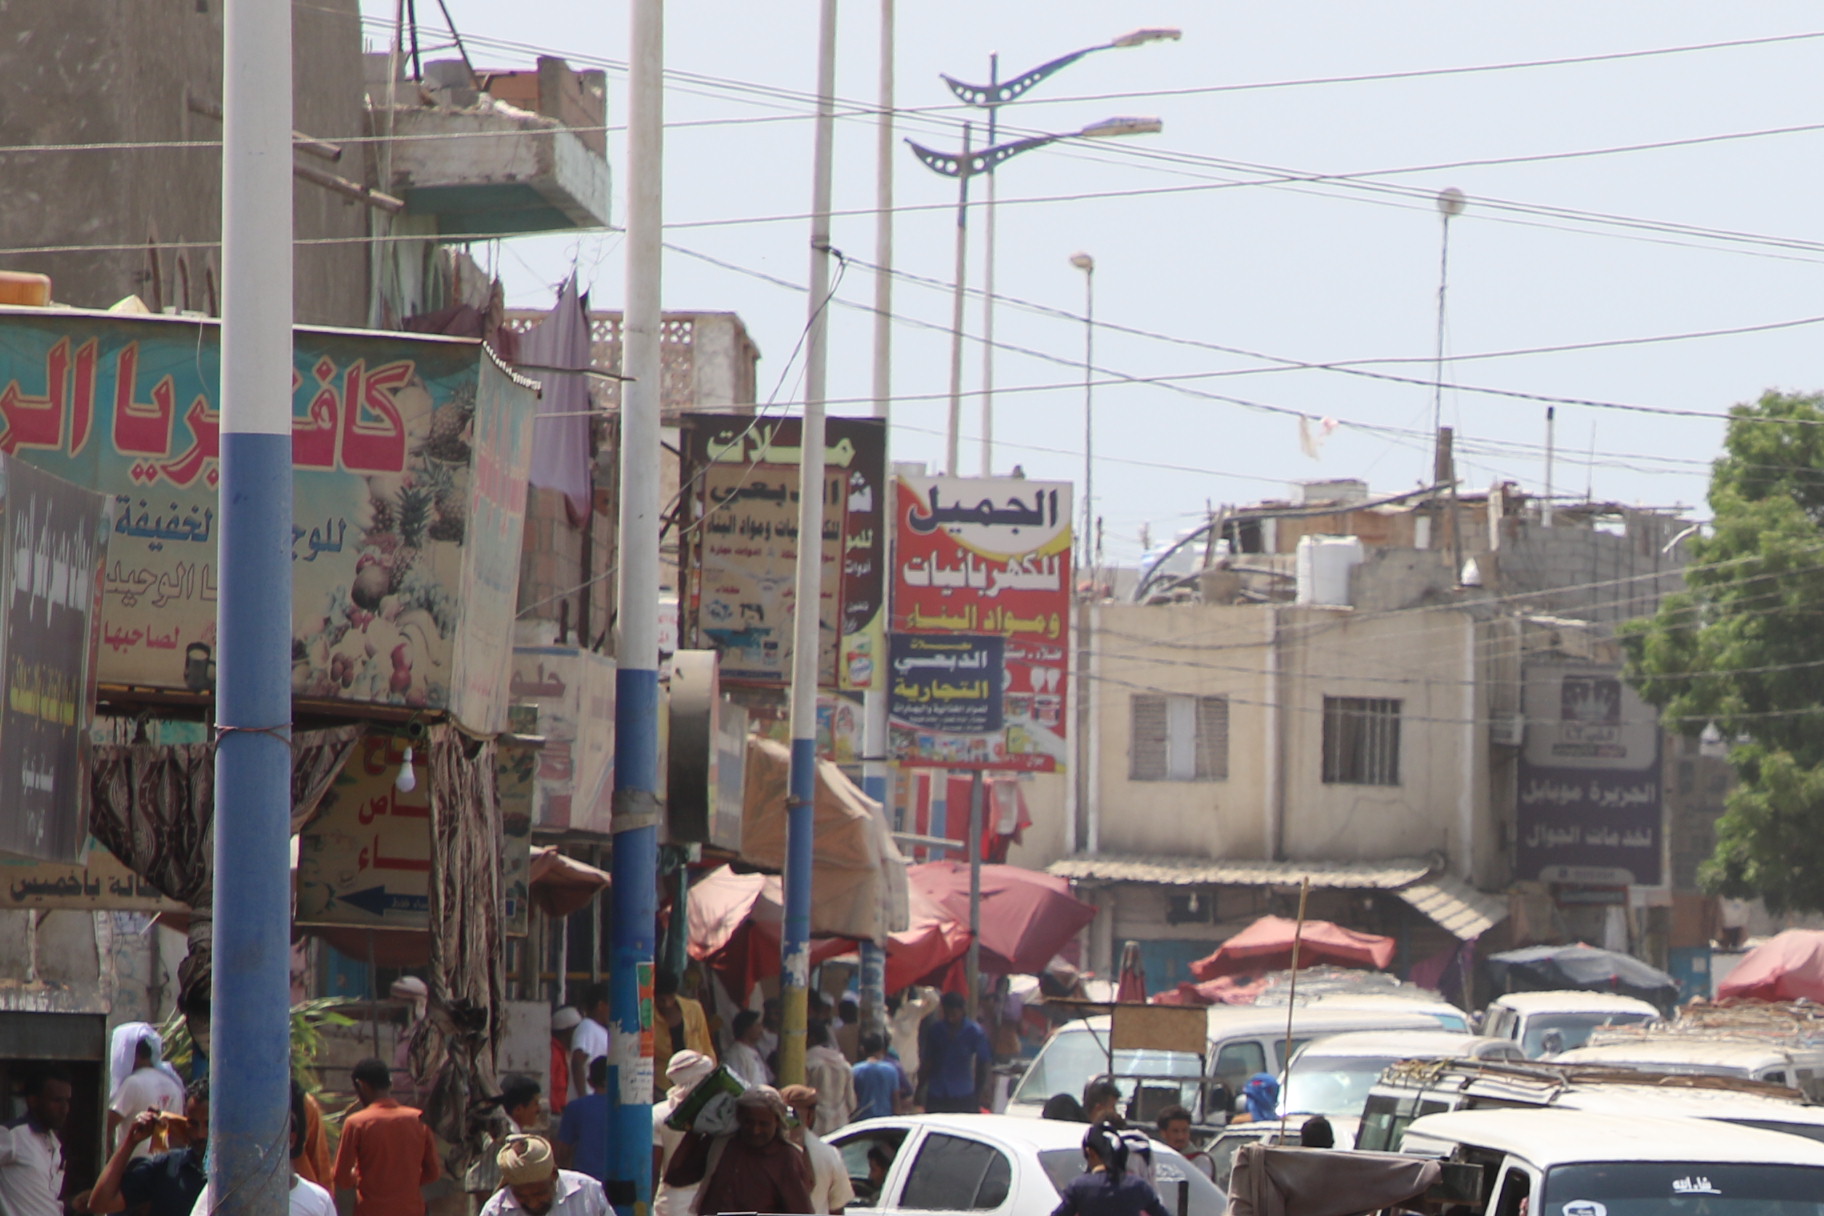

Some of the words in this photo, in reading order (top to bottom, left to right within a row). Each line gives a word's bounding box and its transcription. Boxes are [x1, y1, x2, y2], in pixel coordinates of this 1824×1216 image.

[707, 424, 856, 468] ملات
[114, 495, 213, 552] لخفيفة
[909, 485, 1057, 534] الجميل
[105, 561, 195, 608] الوحيد
[903, 548, 1060, 597] للكهربائيات
[905, 603, 976, 635] البناء
[983, 604, 1060, 639] ومواد
[104, 621, 180, 654] لصاحبها
[894, 679, 989, 702] التجارية
[1520, 779, 1583, 806] موبايل
[1524, 824, 1581, 848] الجوال
[1584, 825, 1652, 848] لخدمات
